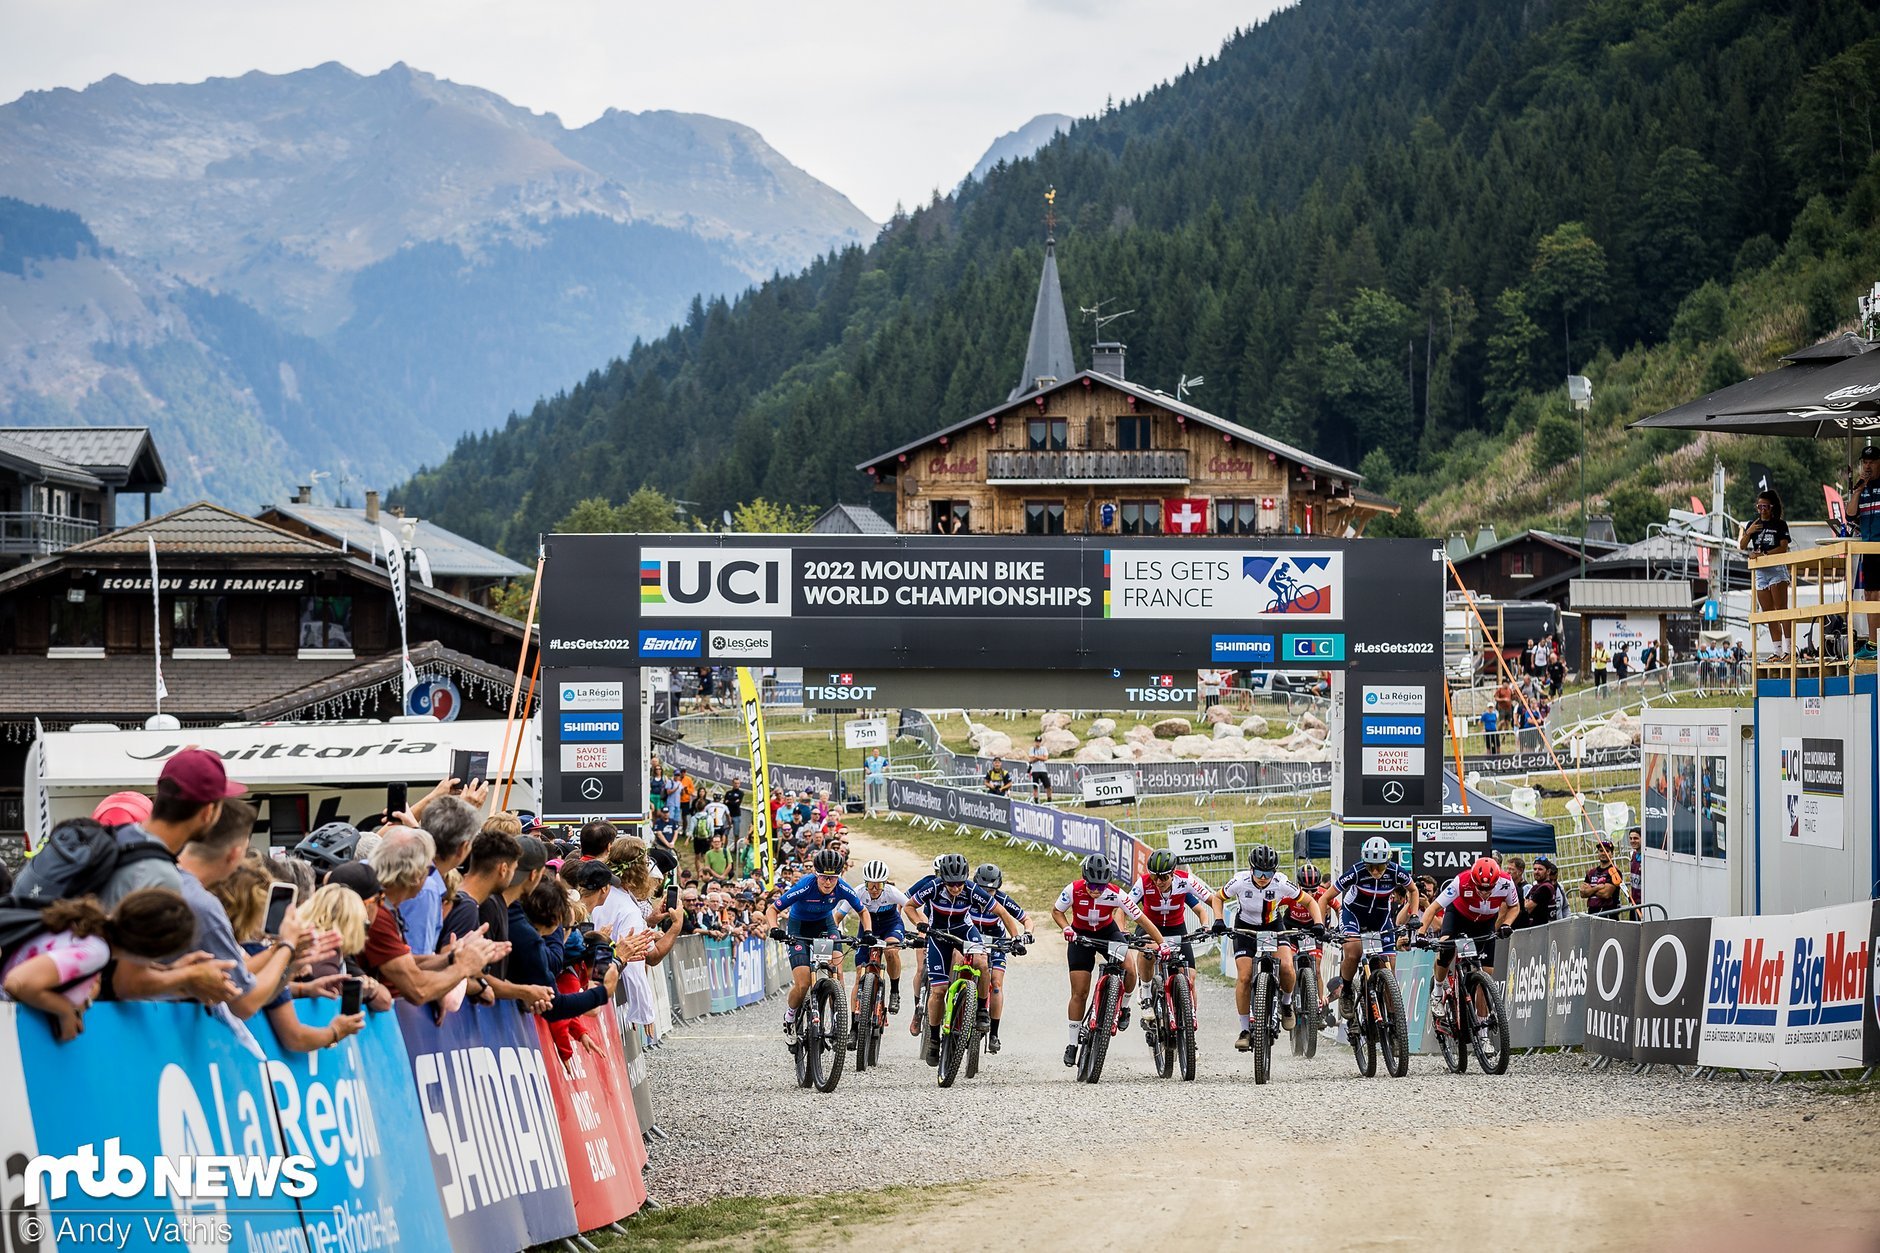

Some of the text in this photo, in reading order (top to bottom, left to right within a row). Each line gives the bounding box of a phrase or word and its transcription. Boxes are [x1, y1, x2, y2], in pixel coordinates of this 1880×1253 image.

[929, 456, 978, 474] Chalet
[803, 560, 1045, 581] 2022 MOUNTAIN BIKE
[1124, 561, 1230, 581] LES GETS
[103, 578, 304, 592] ECOLE DU SKI FRANÇAIS
[667, 560, 779, 604] UCI
[803, 586, 1092, 606] WORLD CHAMPIONSHIPS
[1124, 588, 1213, 607] FRANCE
[549, 638, 630, 651] #LesGets2022
[642, 637, 698, 651] Santini
[1215, 641, 1271, 652] SHIMANO
[1354, 642, 1434, 655] #LesGets2022
[1609, 641, 1643, 650] HOPP
[577, 688, 620, 697] La Région
[805, 686, 877, 700] TISSOT
[1125, 688, 1197, 702] TISSOT
[1380, 692, 1423, 701] La Région
[564, 722, 620, 731] SHIMANO
[1366, 726, 1421, 735] SHIMANO
[855, 730, 877, 738] 75m
[782, 773, 833, 795] Mercedes-Benz
[1095, 785, 1123, 796] 50m
[902, 786, 942, 812] Mercedes-Benz
[958, 796, 1007, 824] Mercedes-Benz
[1014, 807, 1054, 840] SHIMANO
[1382, 820, 1404, 829] UCI
[1062, 819, 1100, 851] SHIMANO
[1184, 838, 1218, 850] 25m
[1179, 854, 1227, 863] Mercedes-Benz
[1423, 851, 1483, 868] START
[821, 944, 826, 952] 7
[1708, 938, 1784, 1025] BigMat
[1789, 931, 1869, 1025] BigMat
[1587, 1007, 1627, 1043] OAKLEY
[1634, 1017, 1697, 1049] OAKLEY
[1758, 1032, 1775, 1044] MAISON
[1843, 1028, 1862, 1041] MAISON
